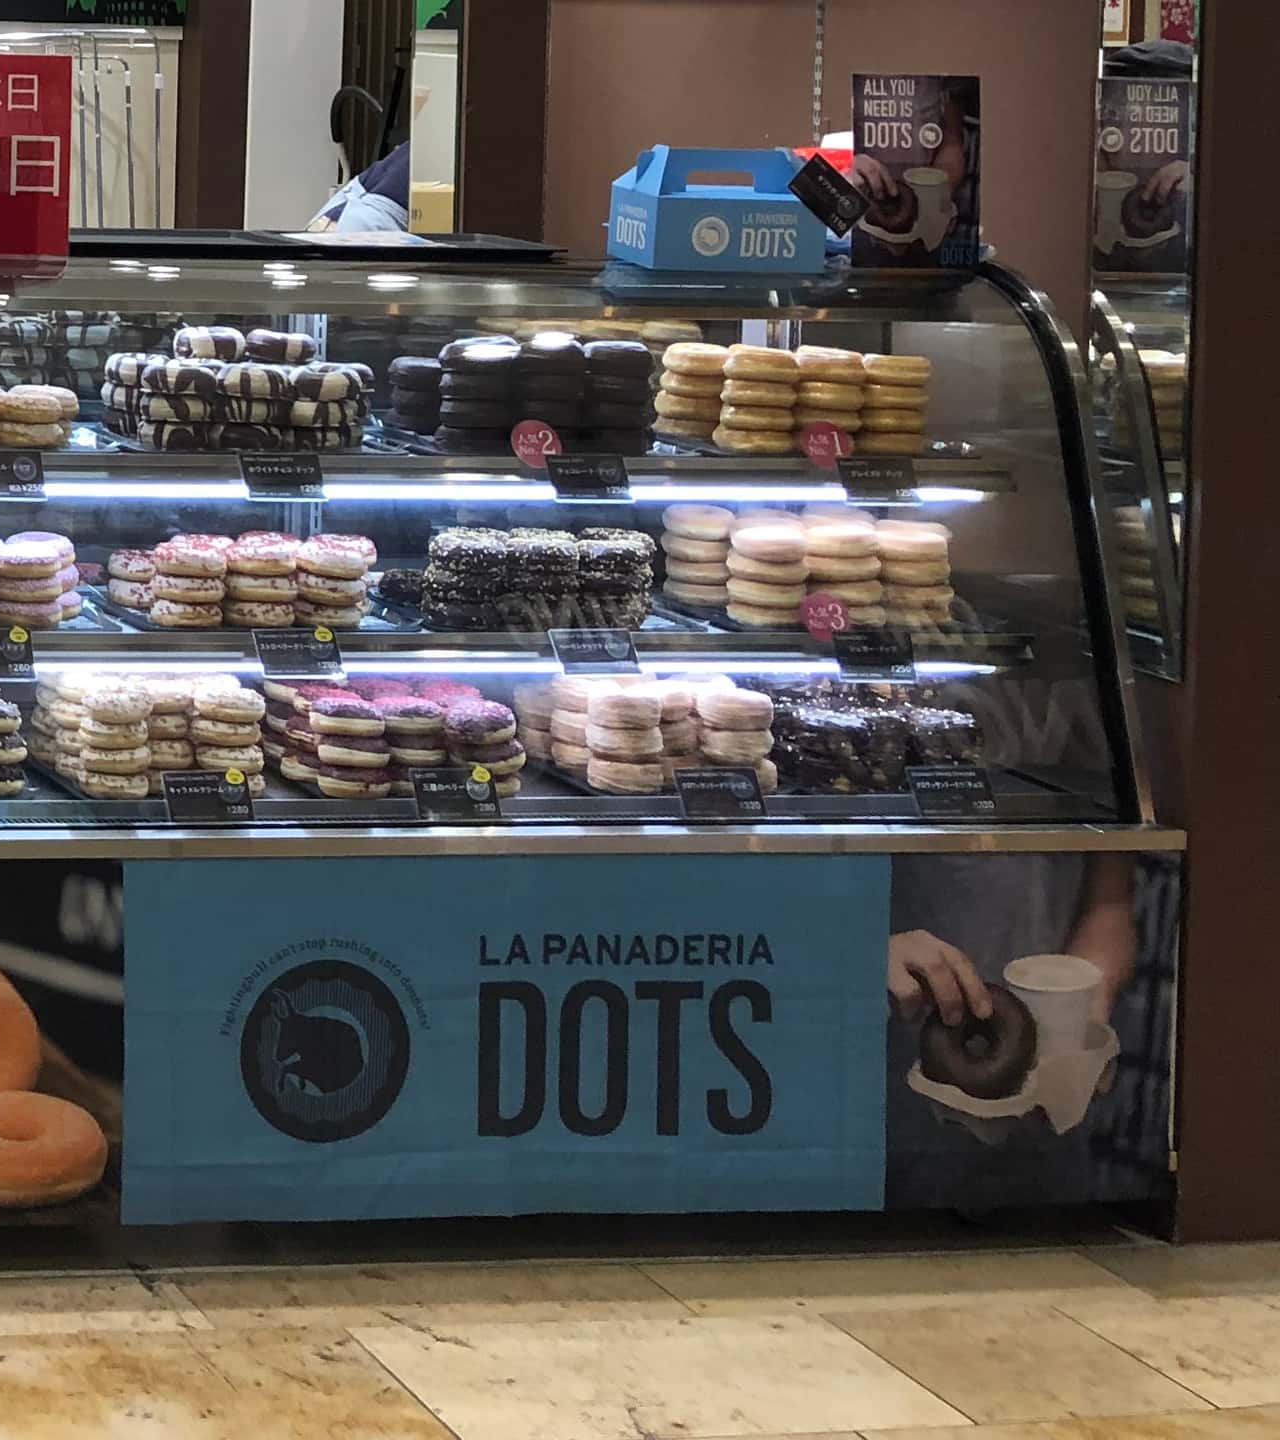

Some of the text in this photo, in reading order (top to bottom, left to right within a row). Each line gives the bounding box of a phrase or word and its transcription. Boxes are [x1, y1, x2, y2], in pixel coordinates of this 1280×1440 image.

[864, 79, 915, 97] ALL YOU
[864, 100, 913, 118] NEED IS
[864, 122, 913, 149] DOTS
[616, 216, 647, 250] DOTS
[740, 227, 797, 258] DOTS
[479, 933, 775, 967] LA PANADERIA
[478, 980, 773, 1136] DOTS
